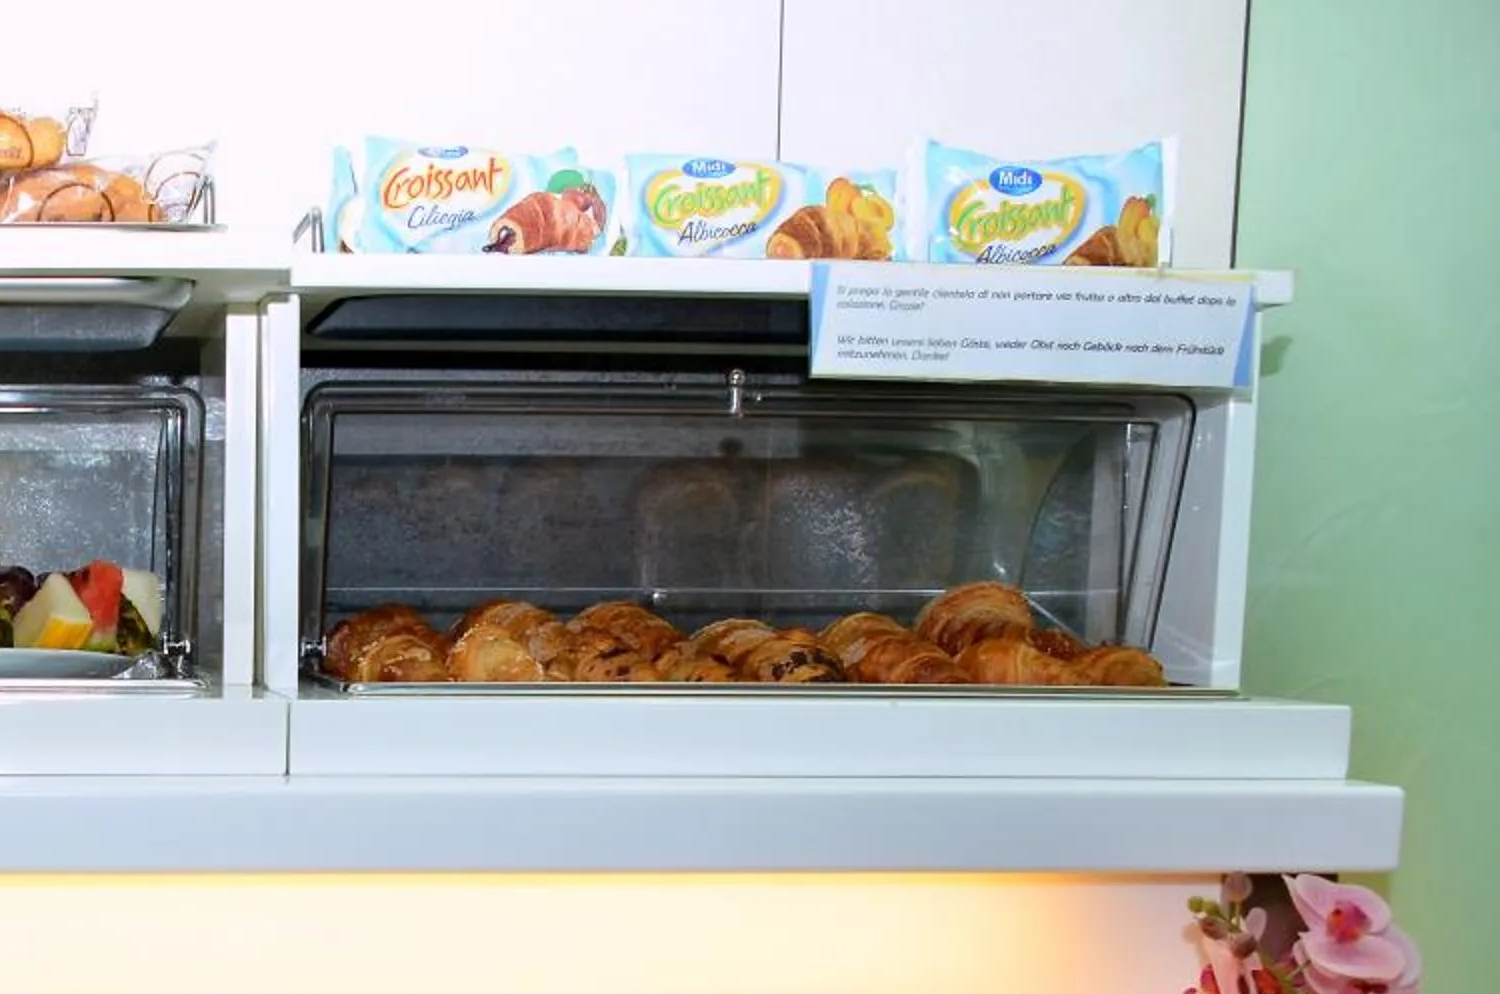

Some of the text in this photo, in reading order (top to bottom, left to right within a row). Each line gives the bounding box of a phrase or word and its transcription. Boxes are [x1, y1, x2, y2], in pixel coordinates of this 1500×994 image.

[384, 156, 503, 209] Croissant
[654, 168, 771, 224] Croissant
[999, 171, 1033, 186] Midi
[677, 220, 758, 245] Albicocca
[953, 185, 1075, 243] Croissant
[976, 243, 1058, 265] Albicocca
